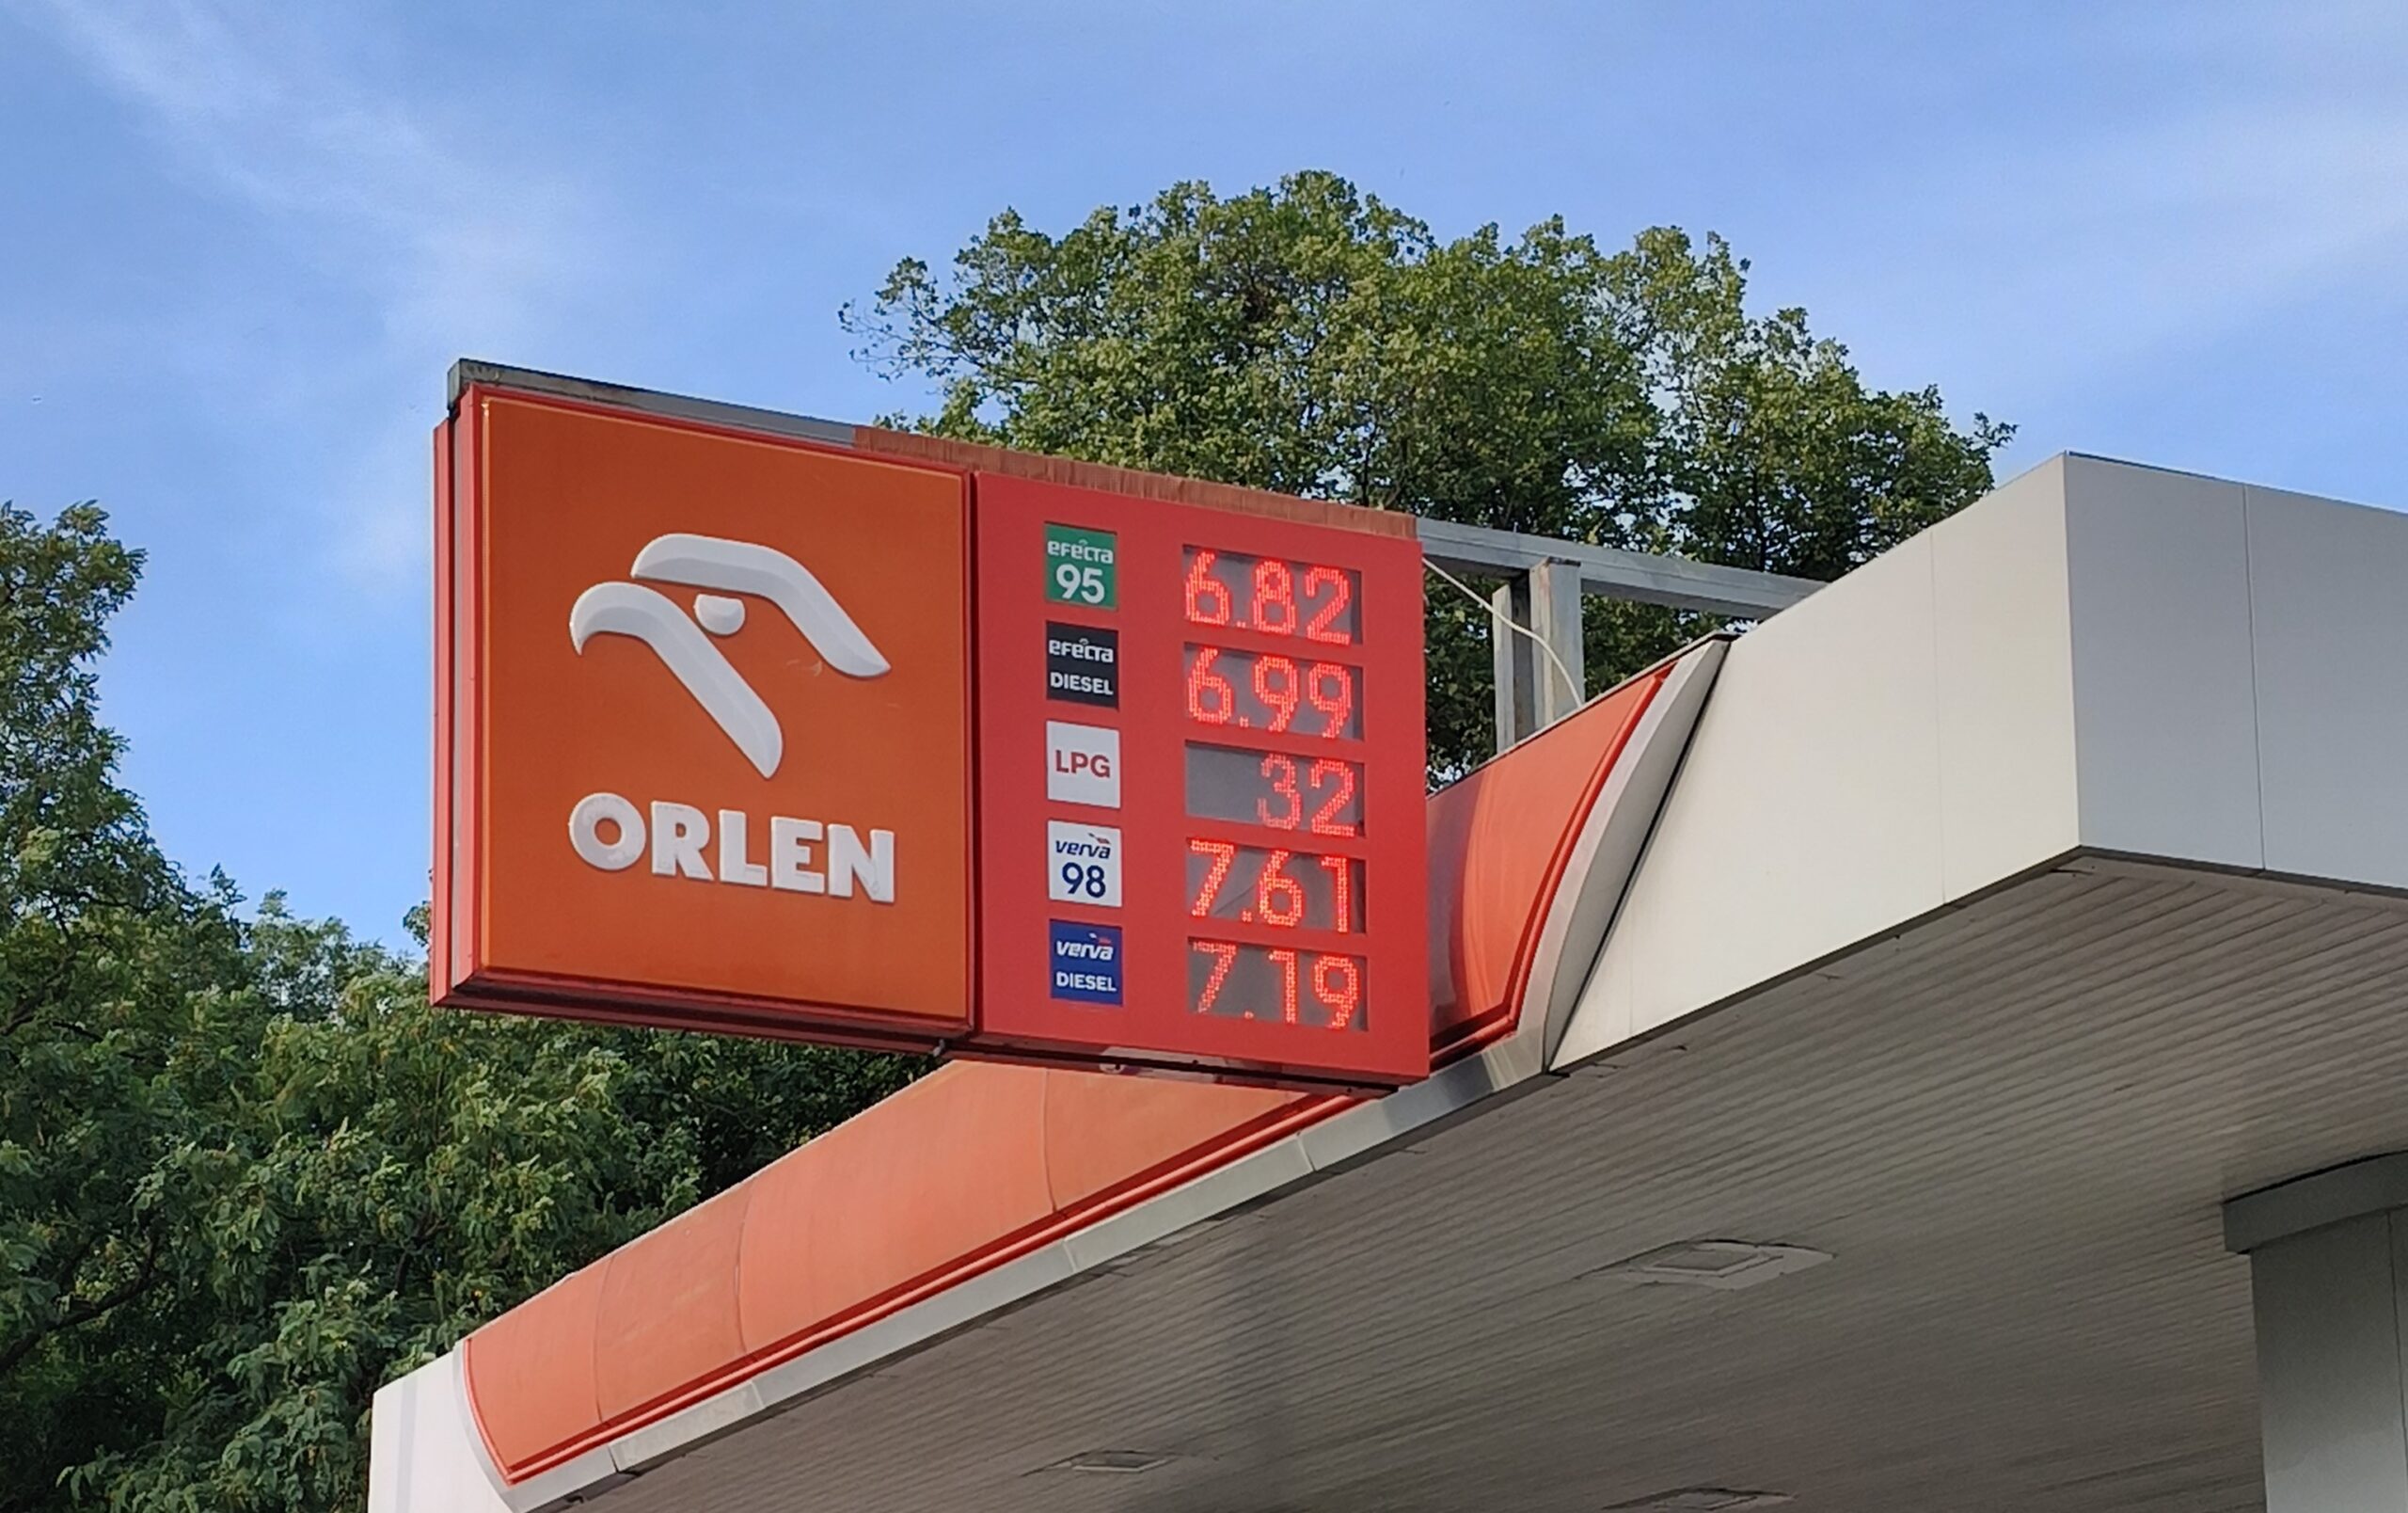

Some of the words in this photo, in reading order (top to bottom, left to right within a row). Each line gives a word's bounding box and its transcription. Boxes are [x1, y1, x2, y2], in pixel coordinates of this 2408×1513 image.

[1055, 564, 1105, 603] 95
[1185, 551, 1351, 645] 6.82
[1050, 671, 1114, 695] DIESEL
[1188, 648, 1353, 739] 6.99
[1055, 750, 1111, 778] LPG
[1258, 753, 1354, 836] 32
[568, 791, 895, 903] ORLEN
[1054, 838, 1111, 860] verva
[1061, 862, 1106, 898] 98
[1190, 839, 1349, 932] 7.61
[1055, 939, 1114, 961] verva
[1055, 972, 1117, 993] DIESEL
[1192, 941, 1358, 1028] 7.19
